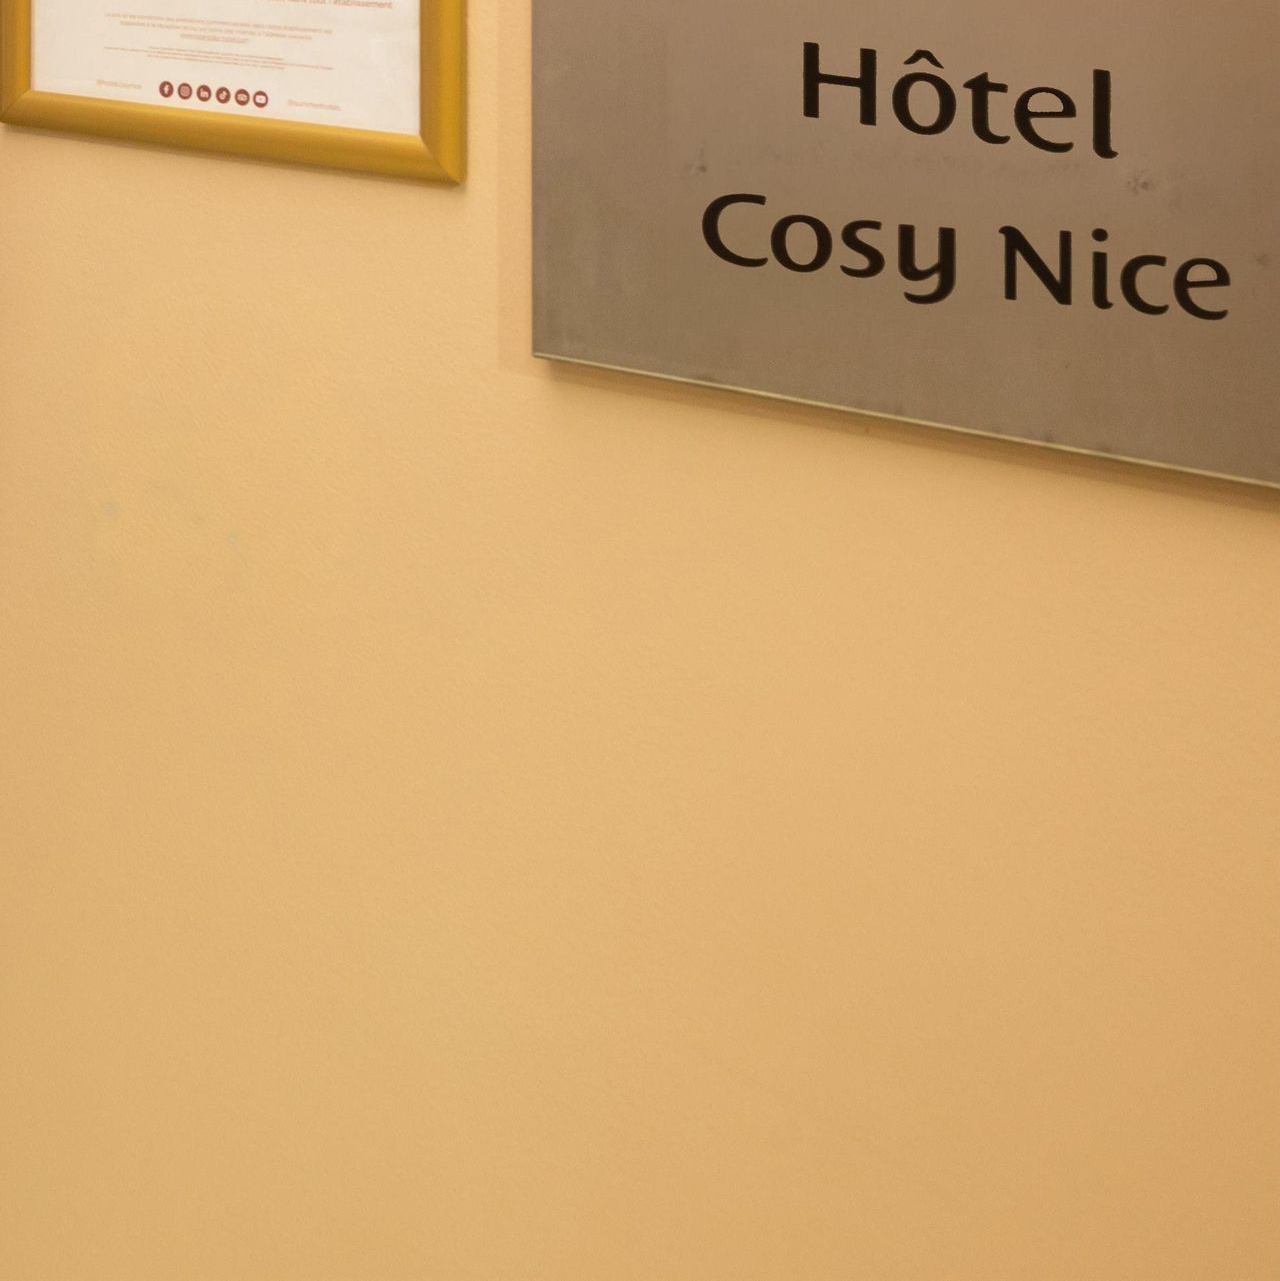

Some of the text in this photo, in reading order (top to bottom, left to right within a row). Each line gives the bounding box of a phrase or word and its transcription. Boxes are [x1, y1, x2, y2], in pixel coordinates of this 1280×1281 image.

[803, 41, 1119, 159] Hôtel
[702, 193, 1230, 320] Cosy Nice
